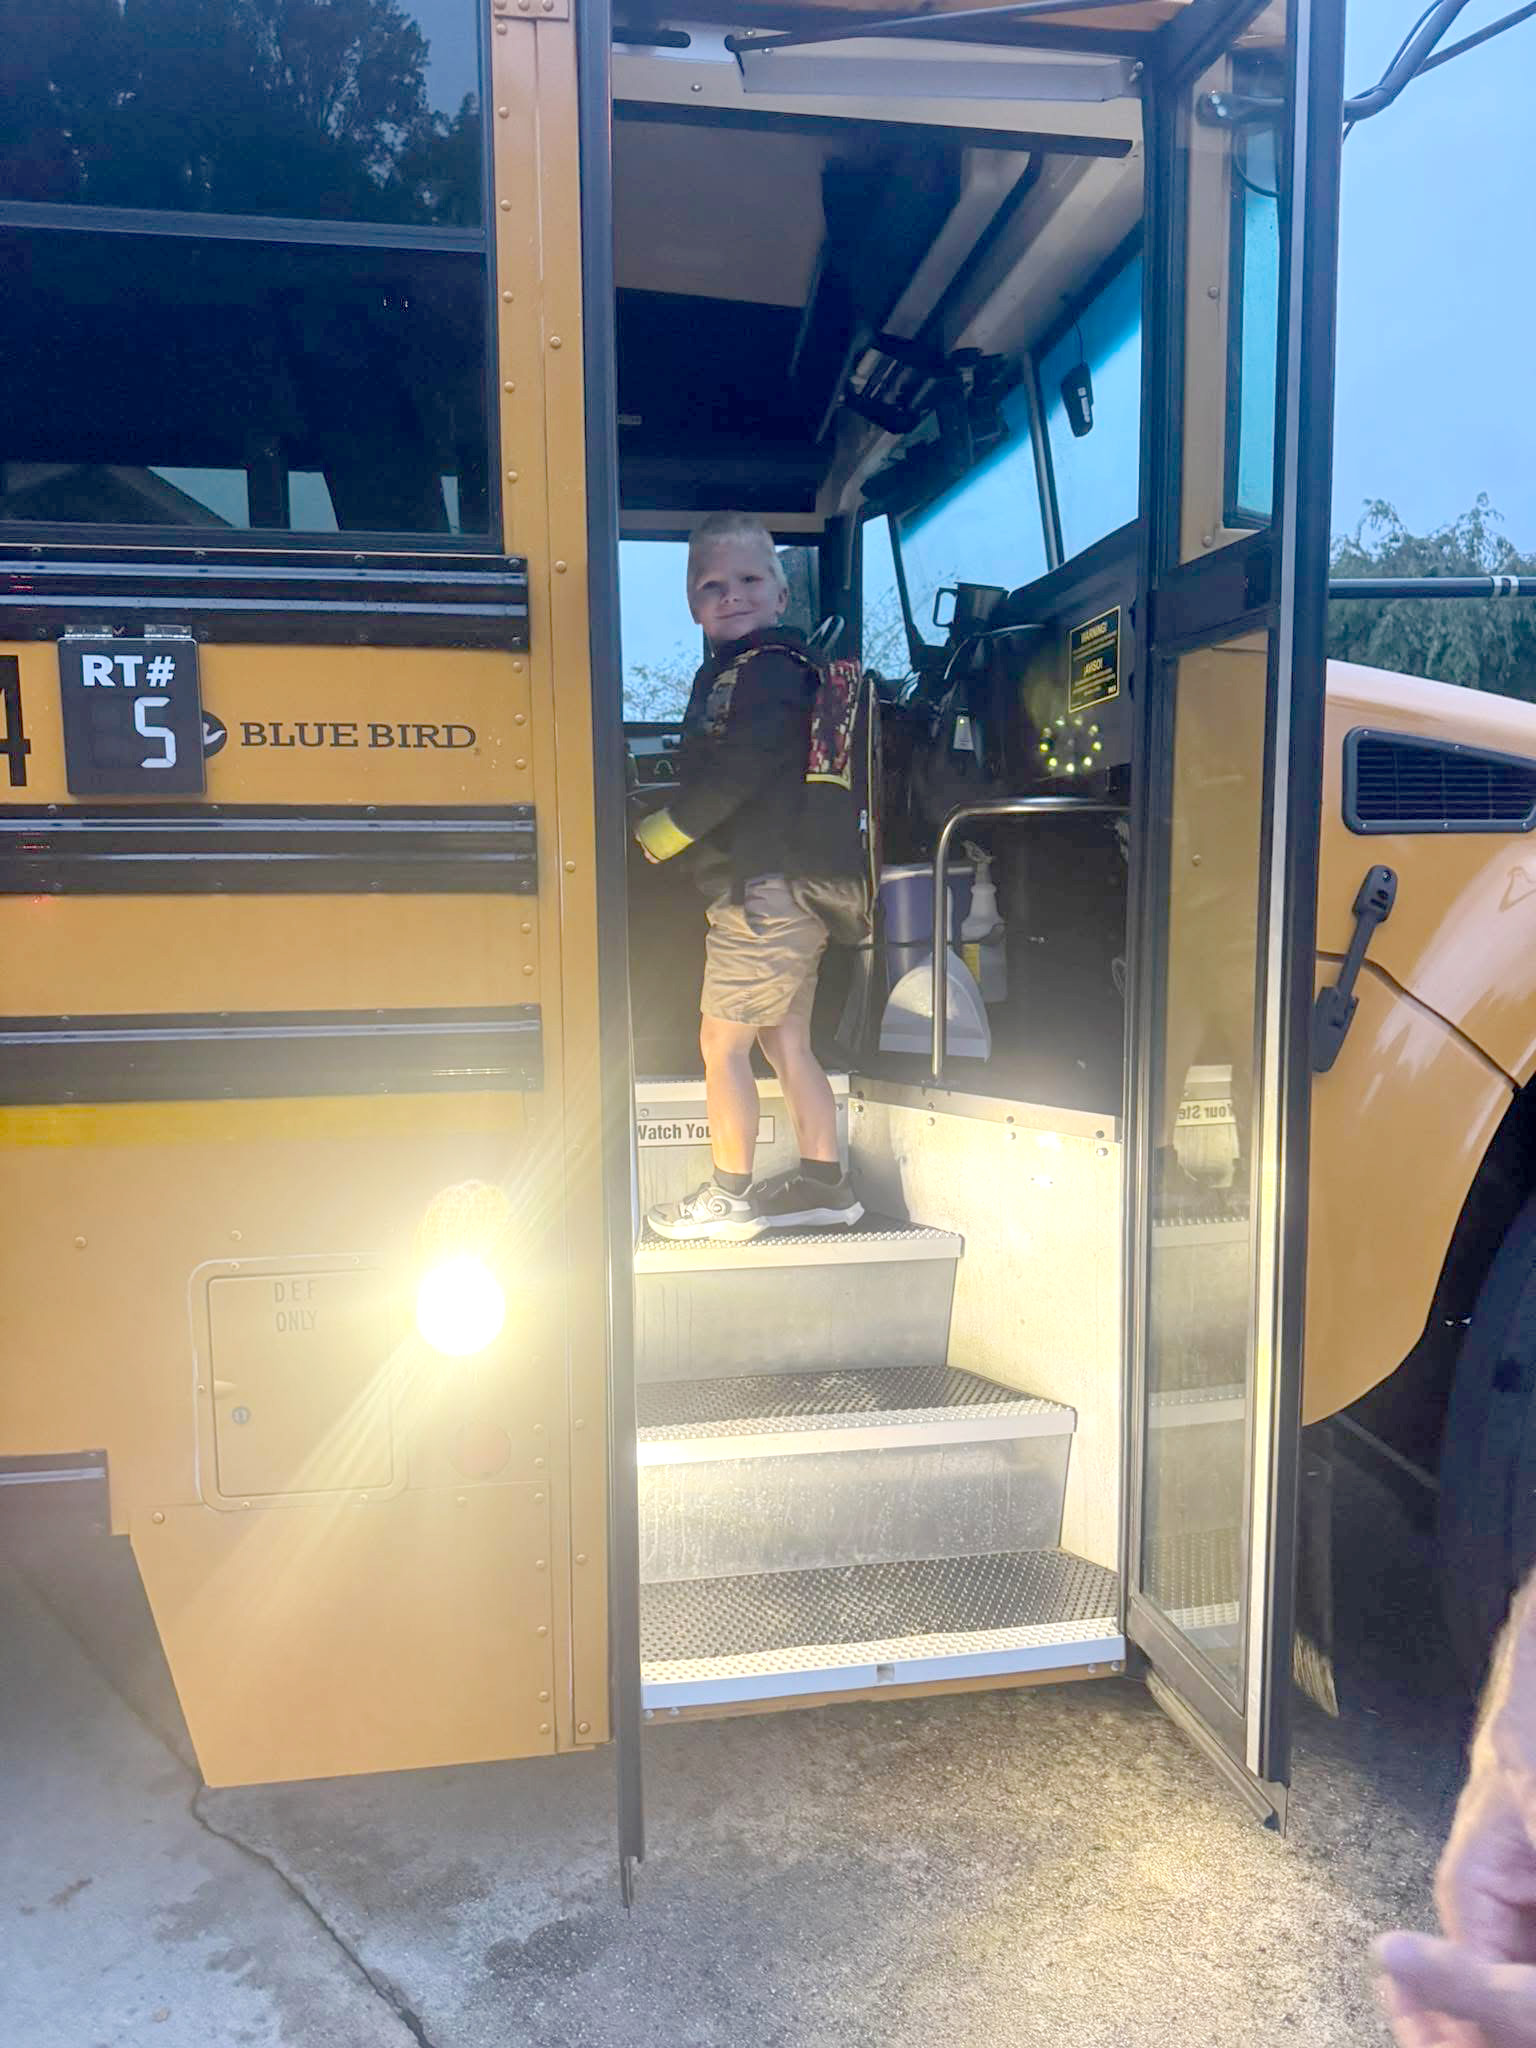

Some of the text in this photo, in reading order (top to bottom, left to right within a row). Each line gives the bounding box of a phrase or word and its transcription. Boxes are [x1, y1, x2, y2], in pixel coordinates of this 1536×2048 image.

[82, 654, 176, 687] RT#
[134, 696, 177, 769] 5
[239, 722, 477, 749] BLUE BIRD
[275, 1309, 319, 1332] ONLY
